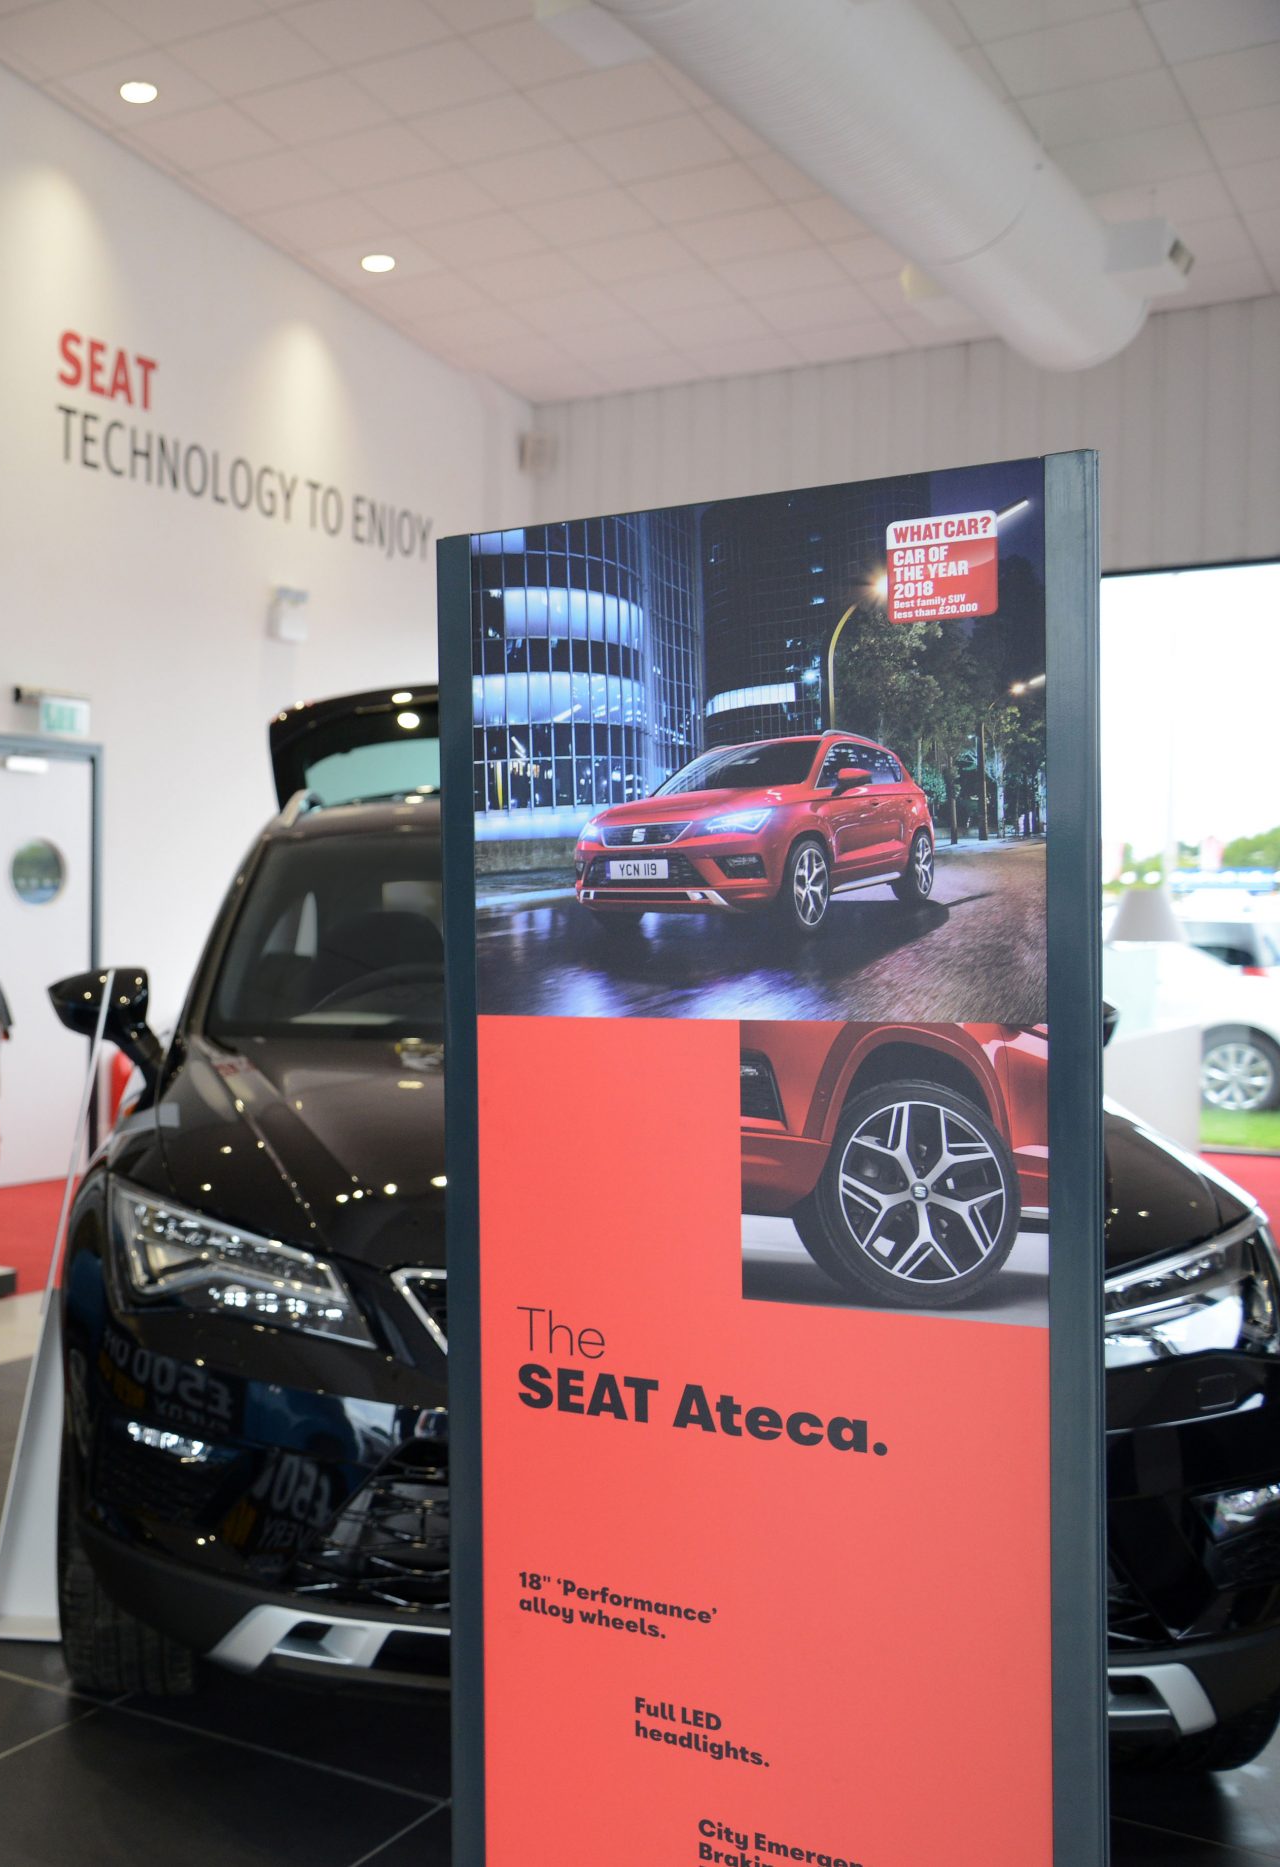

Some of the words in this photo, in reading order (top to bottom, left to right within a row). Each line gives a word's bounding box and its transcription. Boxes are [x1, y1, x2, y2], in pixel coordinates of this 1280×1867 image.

[57, 329, 158, 411] SEAT
[57, 404, 299, 523] TECHNOLOGY
[305, 479, 343, 537] TO
[351, 496, 433, 561] ENJOY
[893, 522, 942, 544] WHAT
[943, 516, 992, 539] CAR?
[893, 548, 926, 567] CAR
[928, 545, 949, 563] OF
[893, 565, 925, 583] THE
[927, 560, 969, 579] YEAR
[893, 581, 934, 599] 2018
[893, 600, 915, 609] Best
[916, 596, 946, 607] family
[948, 593, 966, 603] SUV
[893, 610, 913, 619] less
[915, 607, 937, 616] than
[618, 863, 640, 876] YCN
[516, 1306, 606, 1360] The
[517, 1363, 659, 1424] SEAT
[672, 1383, 889, 1457] Ateca.
[518, 1571, 552, 1591] 18"
[518, 1596, 575, 1625] alloy
[579, 1608, 667, 1640] wheels.
[634, 1696, 676, 1722] Full
[680, 1706, 722, 1731] LED
[634, 1720, 771, 1768] headlights.
[698, 1819, 749, 1851] City
